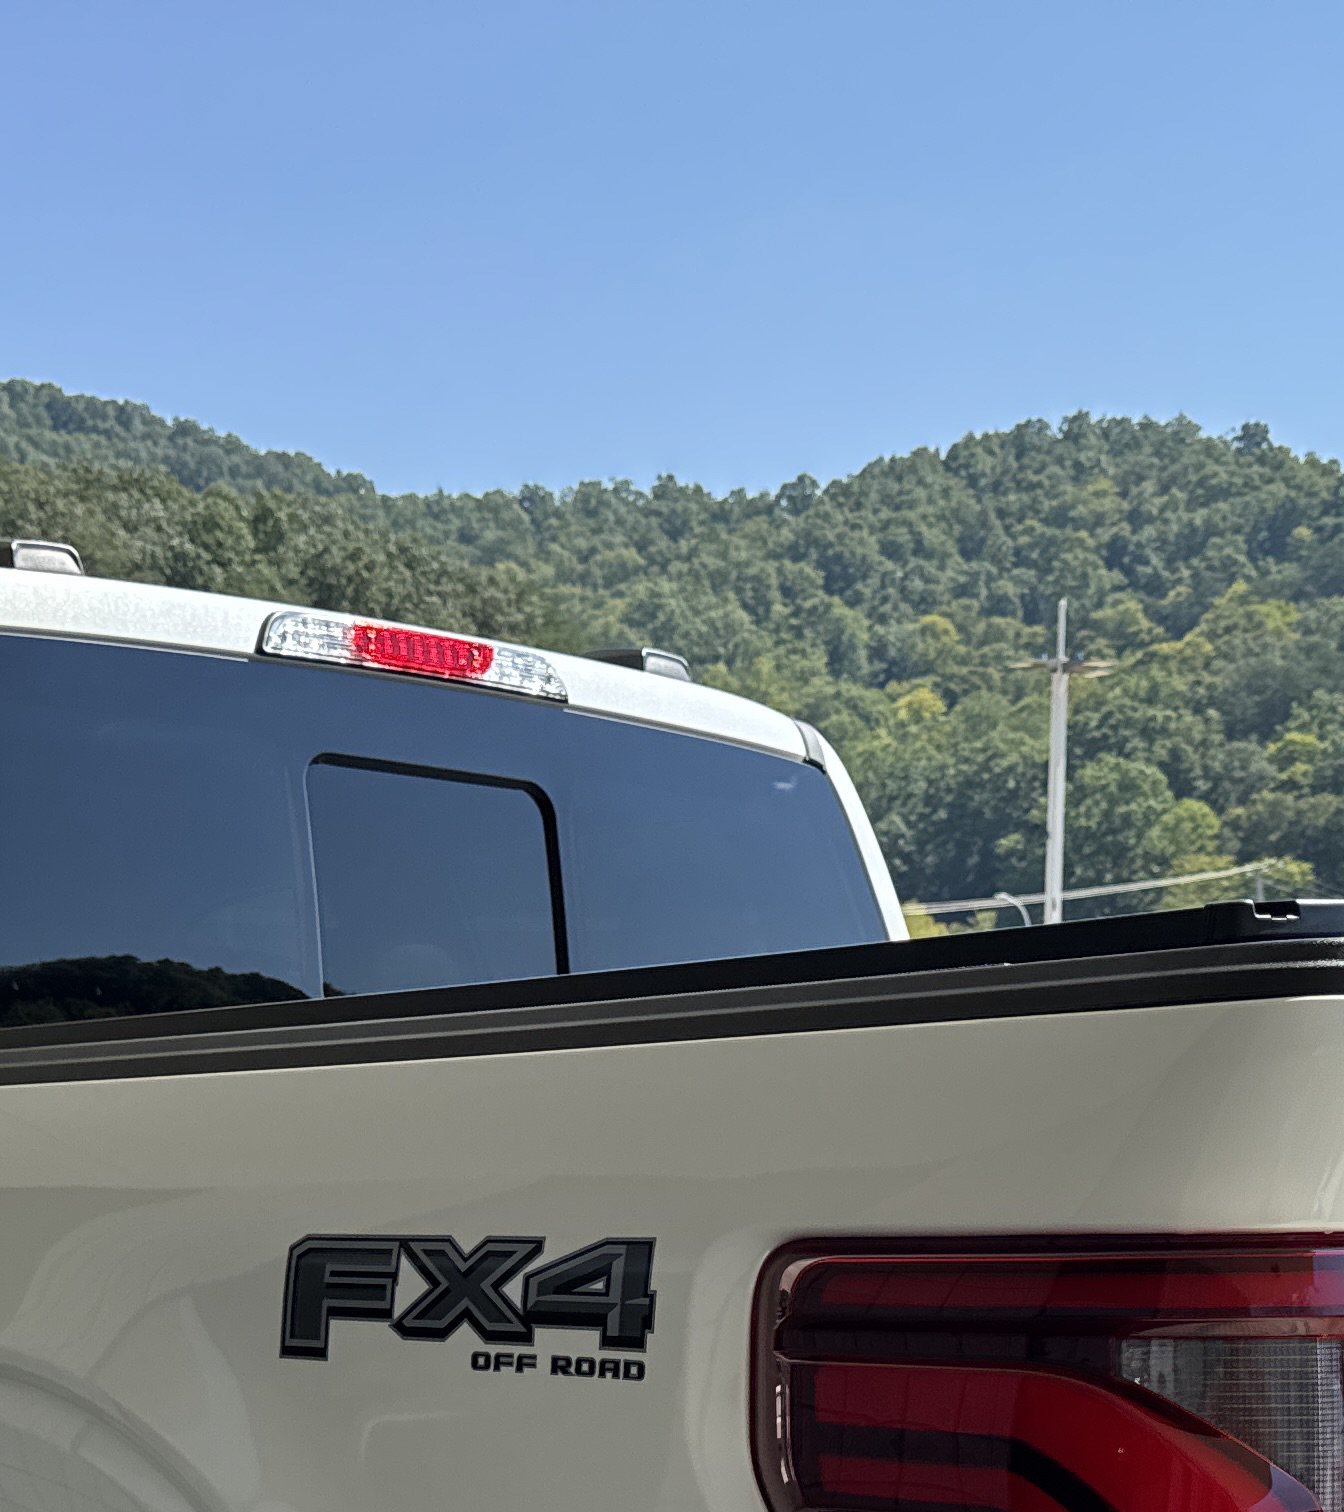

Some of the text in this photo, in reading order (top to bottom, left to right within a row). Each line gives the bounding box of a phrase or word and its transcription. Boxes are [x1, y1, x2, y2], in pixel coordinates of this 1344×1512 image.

[279, 1234, 656, 1361] FX4
[470, 1350, 646, 1382] OFF ROAD
